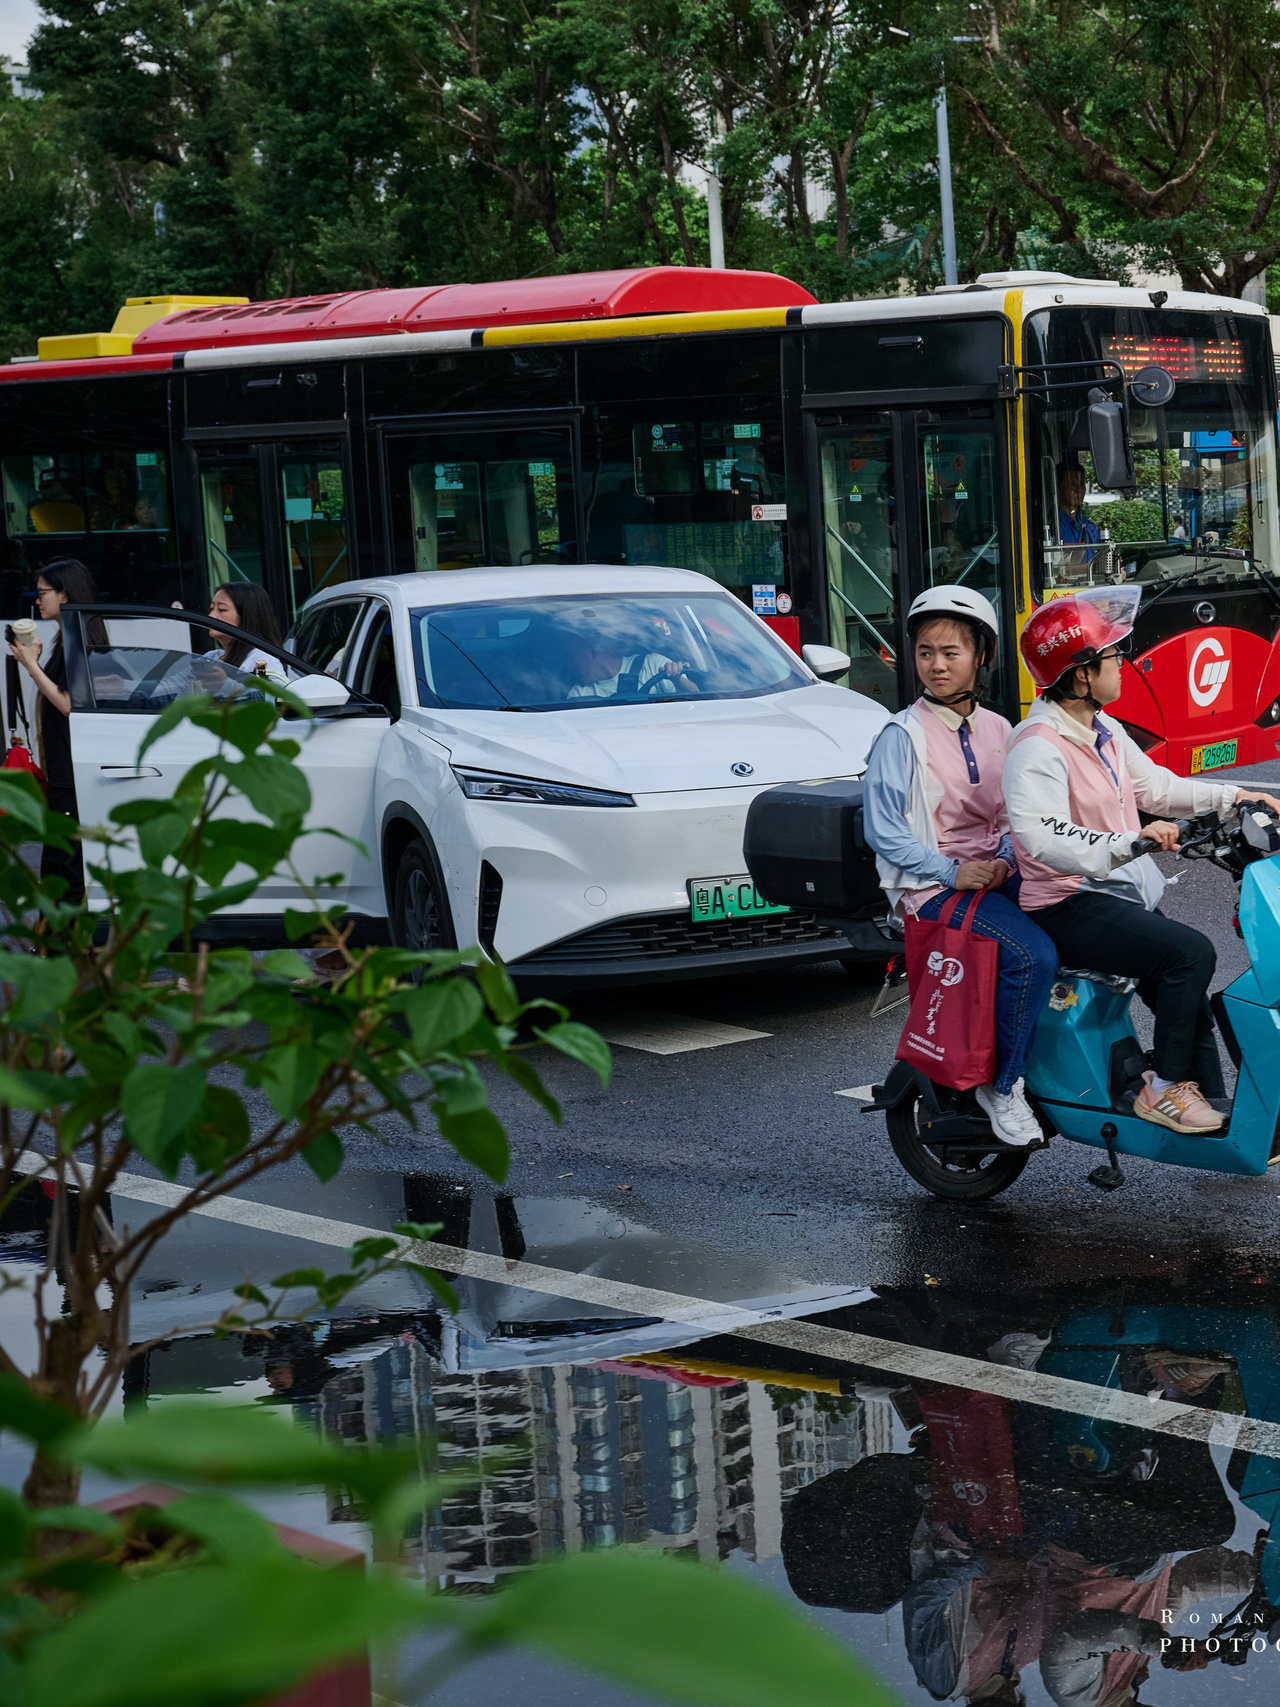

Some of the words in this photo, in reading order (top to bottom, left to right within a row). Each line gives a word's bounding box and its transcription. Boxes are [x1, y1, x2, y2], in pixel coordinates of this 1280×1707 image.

[1036, 624, 1082, 657] 荣兴车行
[1205, 743, 1237, 767] 25926D
[696, 886, 725, 914] 粤A
